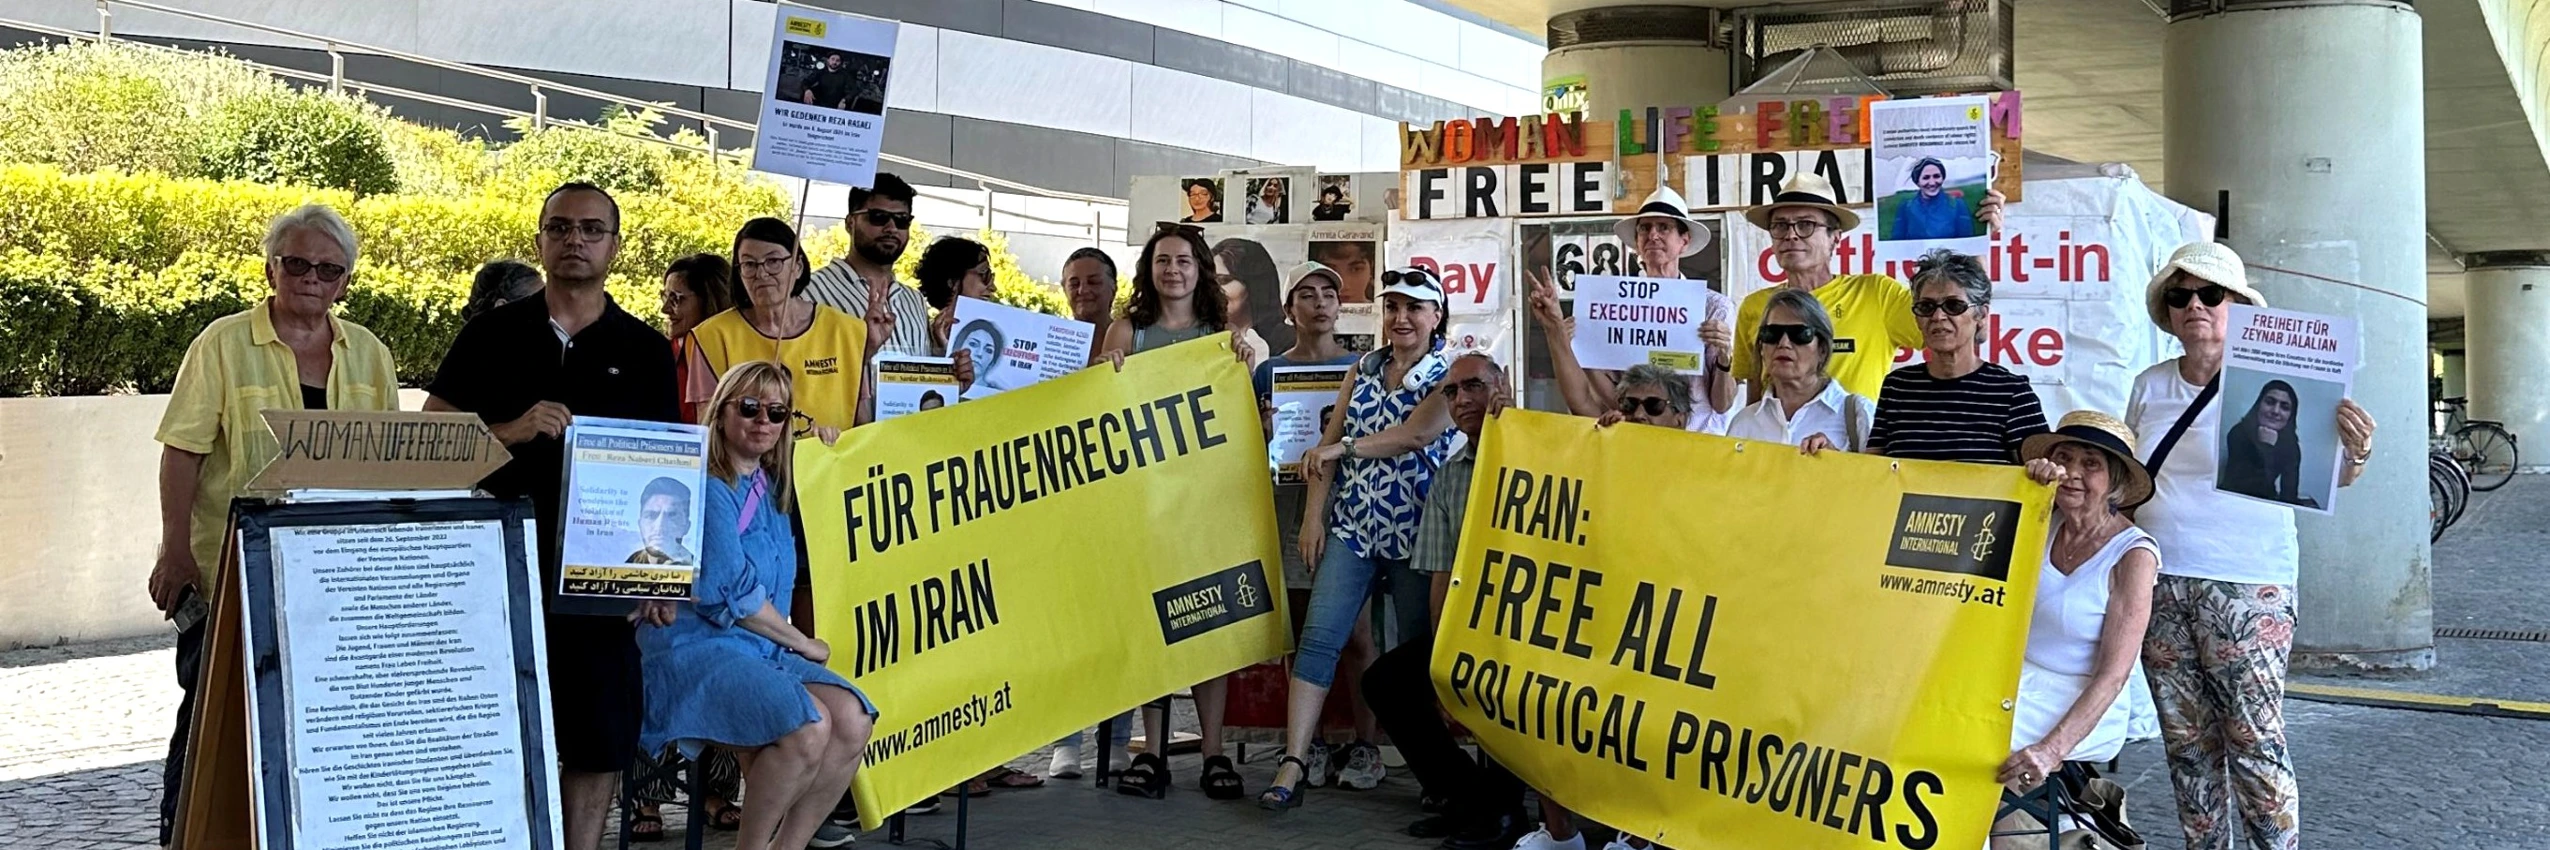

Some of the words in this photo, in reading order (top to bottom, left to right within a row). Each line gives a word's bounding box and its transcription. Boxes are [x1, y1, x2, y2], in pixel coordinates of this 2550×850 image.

[775, 108, 789, 117] WIR
[790, 110, 826, 122] GEDENKEN
[828, 116, 846, 126] REZA
[1399, 112, 1586, 164] WOMAN
[1618, 104, 1721, 156] LIFE
[1419, 162, 1604, 220] FREE
[1706, 148, 1873, 206] IRA
[1990, 232, 2110, 282] it-in
[1618, 281, 1660, 299] STOP
[1589, 303, 1688, 324] EXECUTIONS
[2252, 314, 2304, 332] FREIHEIT
[2306, 319, 2329, 336] FÜR
[1013, 338, 1037, 351] STOP
[1608, 327, 1623, 344] IN
[1630, 328, 1667, 347] IRAN
[2241, 327, 2284, 344] ZEYNAB
[2286, 333, 2337, 352] JALALIAN
[804, 357, 837, 368] AMNESTY
[1002, 348, 1040, 362] EXECUTIONS
[1018, 360, 1032, 370] IRAN
[843, 464, 919, 563] FÜR
[926, 386, 1228, 533] FRAUENRECHTE
[1491, 466, 1590, 547] IRAN:
[573, 517, 602, 525] Human
[1905, 510, 1967, 537] AMNESTY
[395, 534, 430, 542] September
[1900, 536, 1959, 556] INTERNATIONAL
[589, 567, 606, 578] آزاد
[569, 582, 588, 590] کنید
[590, 582, 608, 593] آزاد
[612, 582, 620, 593] را
[622, 584, 649, 594] سیاسی
[652, 583, 685, 596] زندانیان
[1880, 572, 2005, 607] www.amnesty.at
[1166, 585, 1223, 617] AMNESTY
[854, 593, 900, 680] IM
[910, 558, 1000, 655] IRAN
[1170, 603, 1228, 631] INTERNATIONAL
[1469, 549, 1603, 659] FREE
[1610, 581, 1718, 690] ALL
[863, 681, 1012, 769] www.amnesty.at
[1451, 651, 1648, 771] POLITICAL
[1665, 710, 1944, 850] PRISONERS
